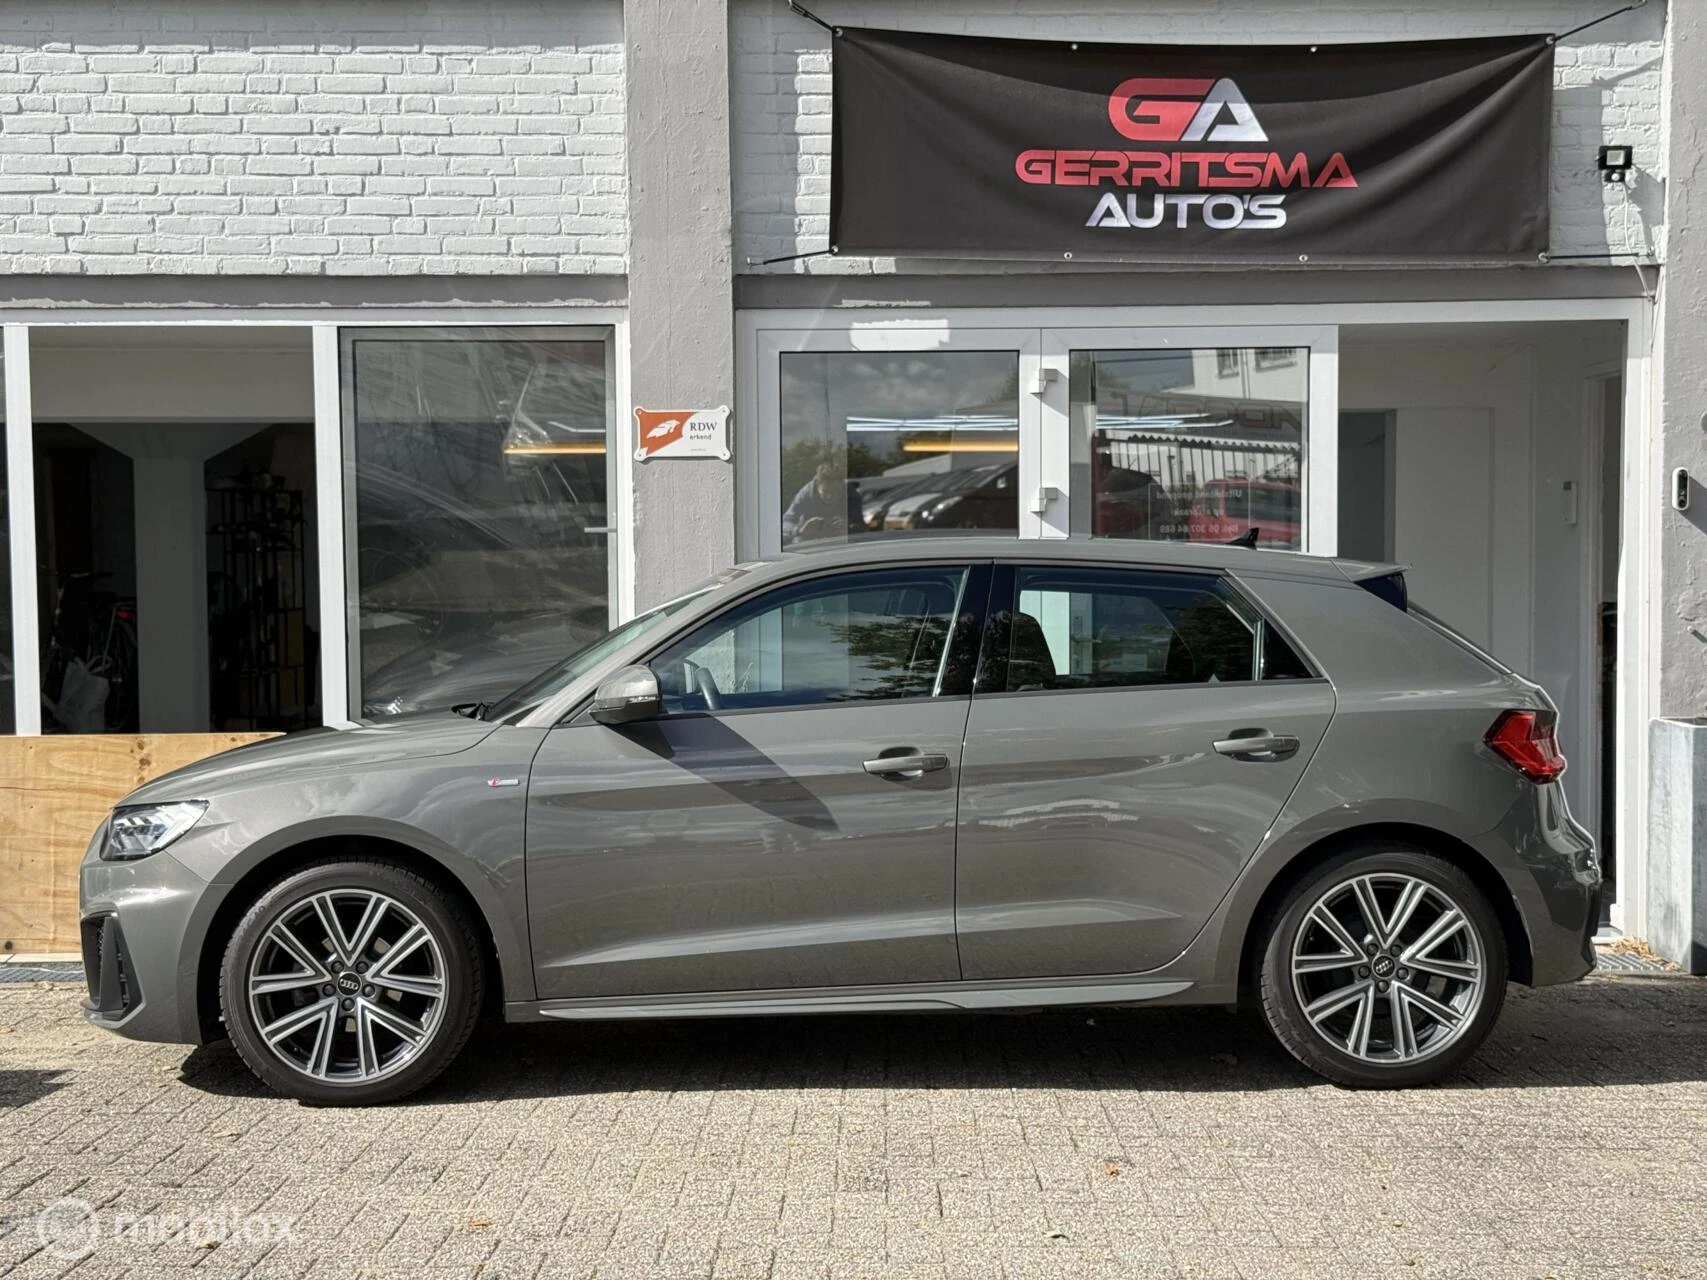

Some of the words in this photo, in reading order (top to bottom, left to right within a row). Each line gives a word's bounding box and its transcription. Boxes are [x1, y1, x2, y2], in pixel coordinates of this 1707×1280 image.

[1107, 77, 1269, 142] GA
[1015, 149, 1359, 188] GERRITSMA
[1084, 192, 1287, 230] AUTO'S
[689, 422, 717, 431] RDW
